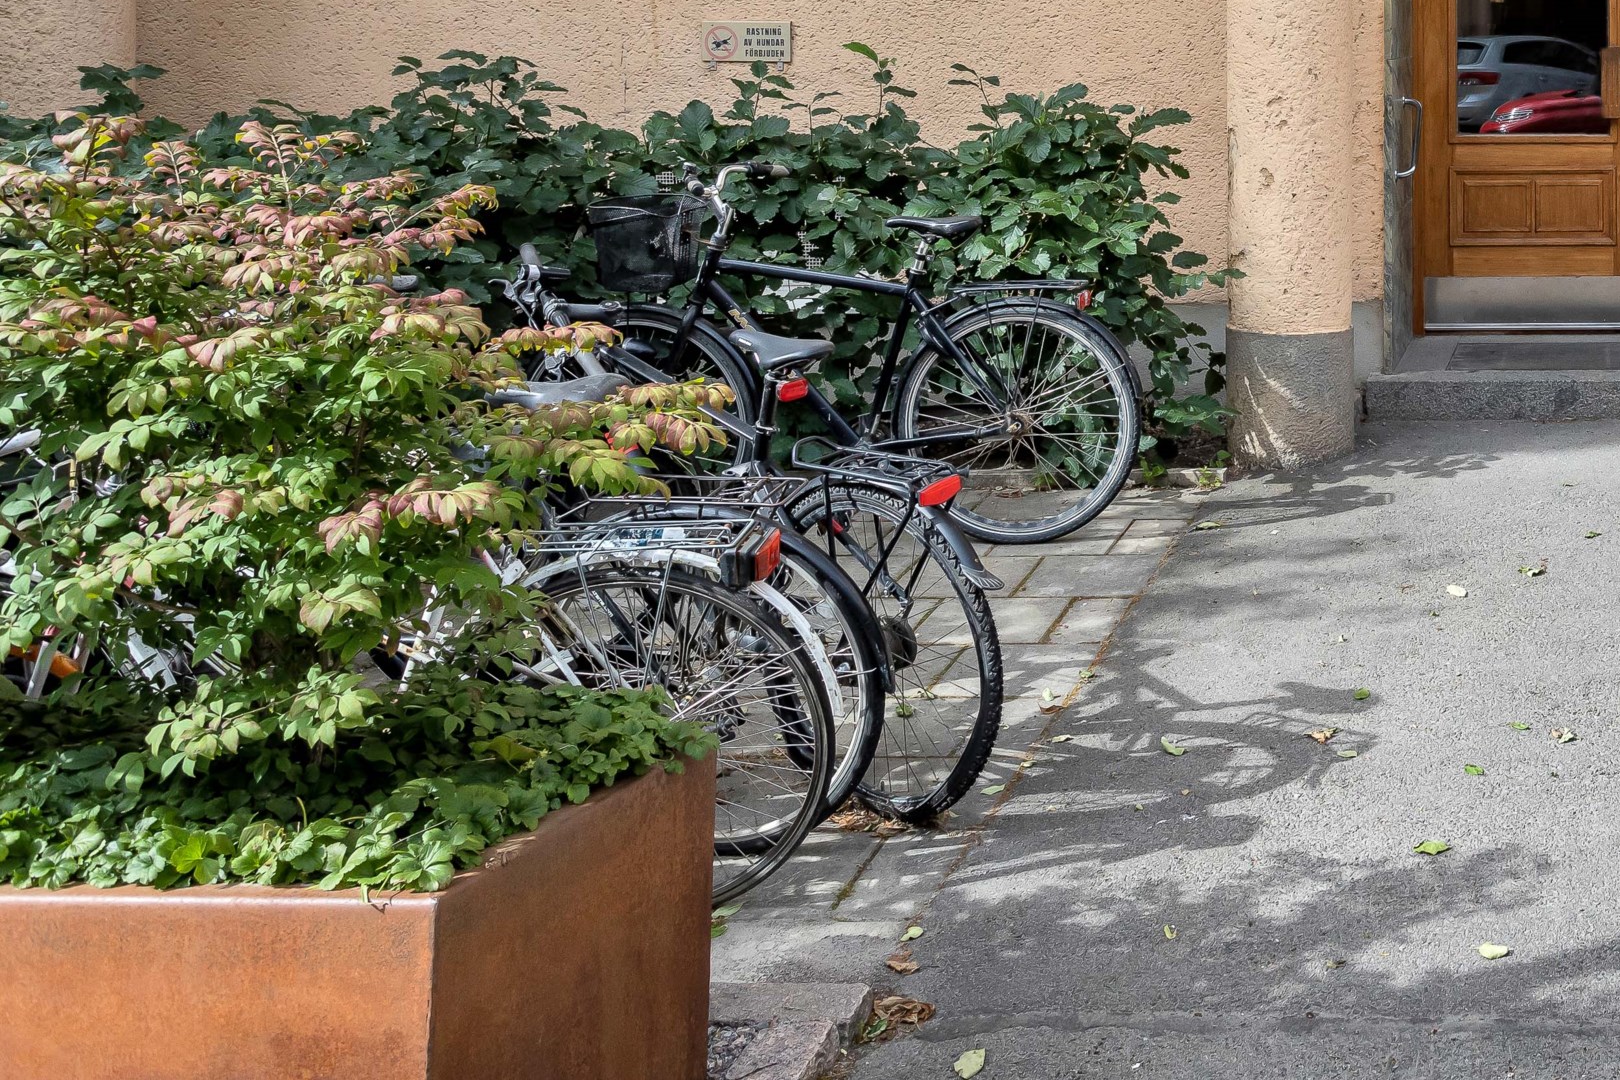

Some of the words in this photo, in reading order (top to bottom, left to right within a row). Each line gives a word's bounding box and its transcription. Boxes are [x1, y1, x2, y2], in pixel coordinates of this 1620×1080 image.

[746, 27, 782, 36] RASTNING
[743, 38, 753, 47] AV
[756, 38, 785, 47] HUNDAR
[745, 49, 785, 58] FÖRBJUDEN
